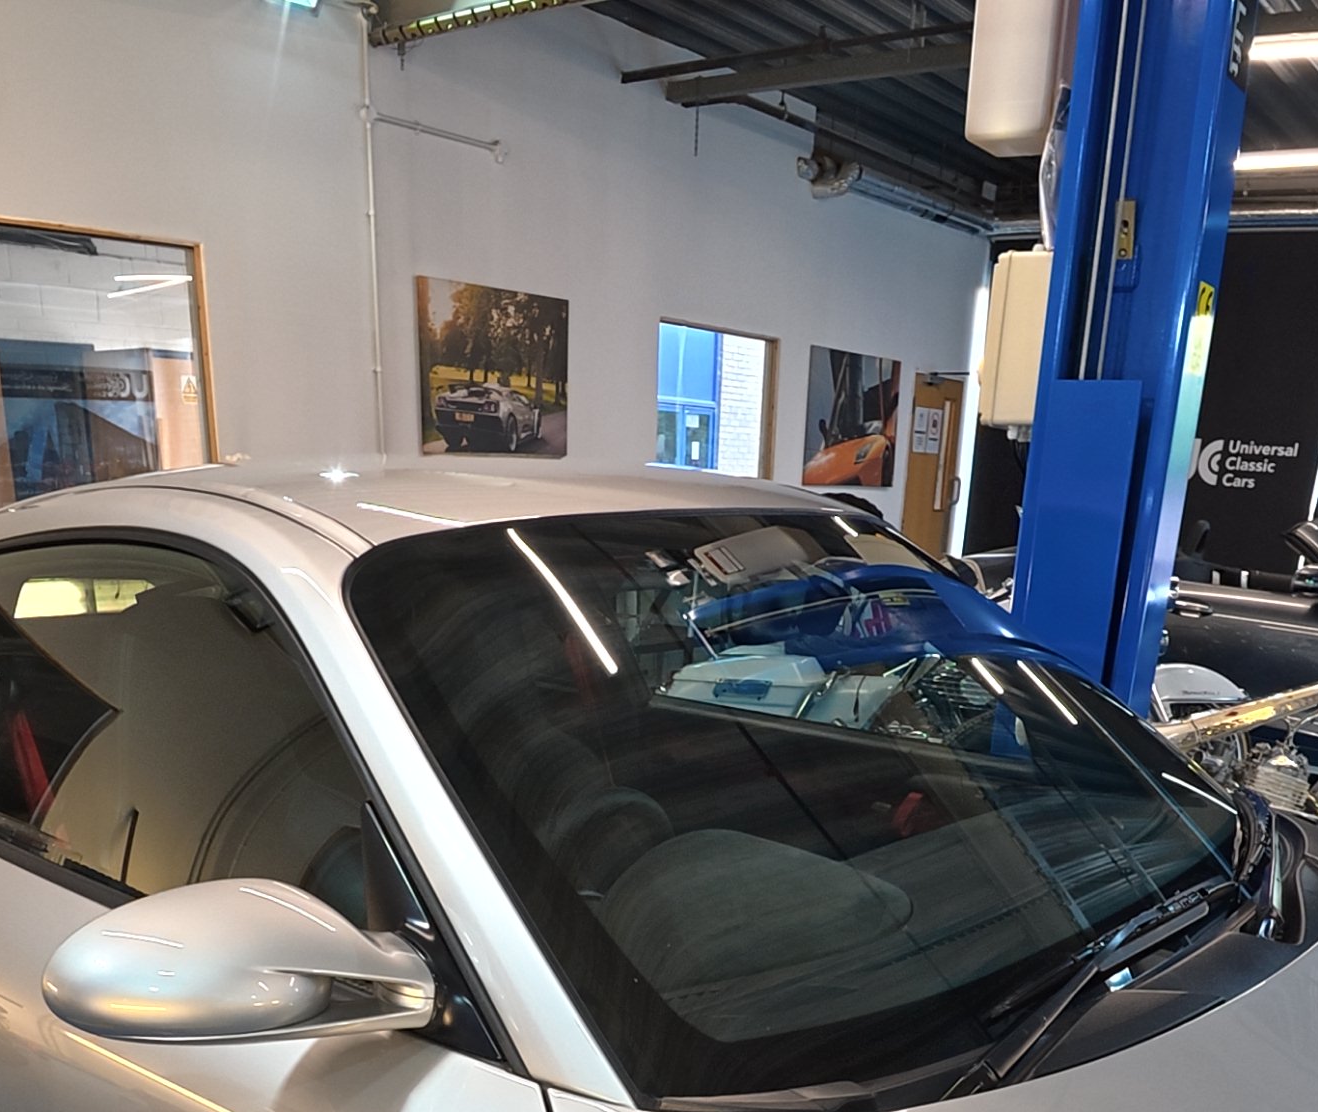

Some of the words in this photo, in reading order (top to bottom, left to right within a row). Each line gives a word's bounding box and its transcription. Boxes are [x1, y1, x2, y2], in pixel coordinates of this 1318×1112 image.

[1228, 440, 1299, 457] Universal
[1225, 456, 1276, 473] Classic
[1222, 473, 1256, 489] Cars
